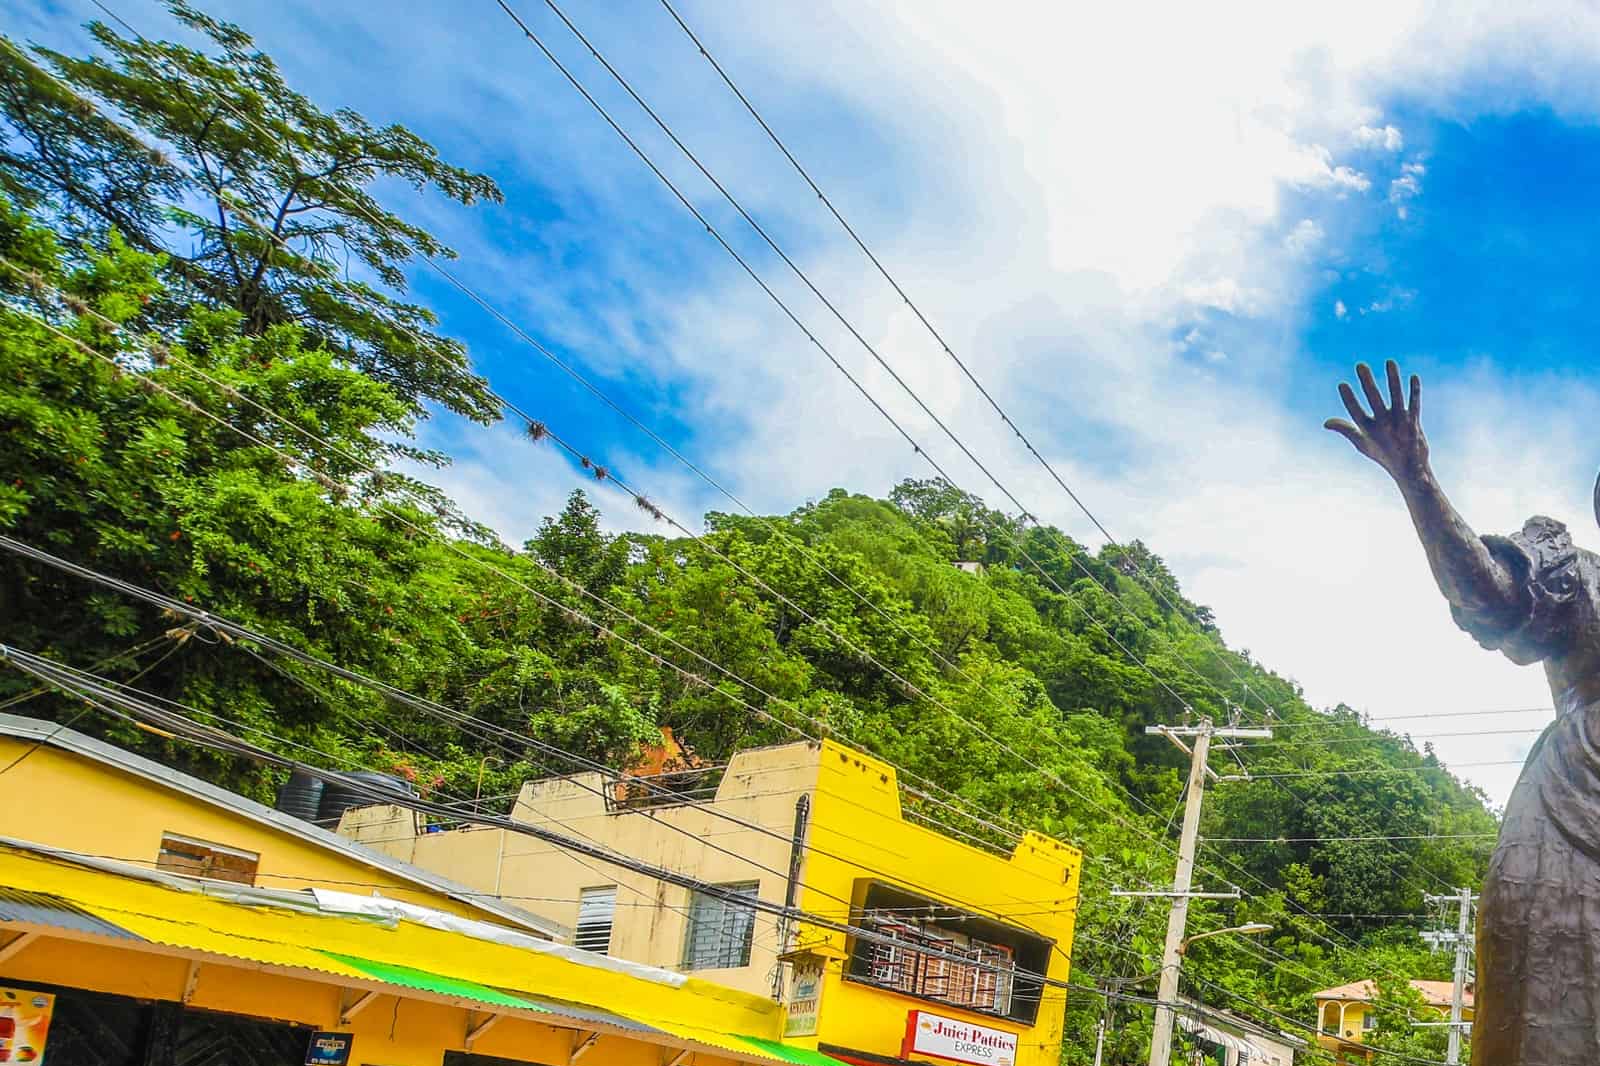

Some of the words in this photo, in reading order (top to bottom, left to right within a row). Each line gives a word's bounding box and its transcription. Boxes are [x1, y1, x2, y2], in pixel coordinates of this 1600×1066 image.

[934, 1021, 968, 1041] Juici
[971, 1029, 1015, 1051] Patties
[954, 1040, 993, 1058] EXPRESS
